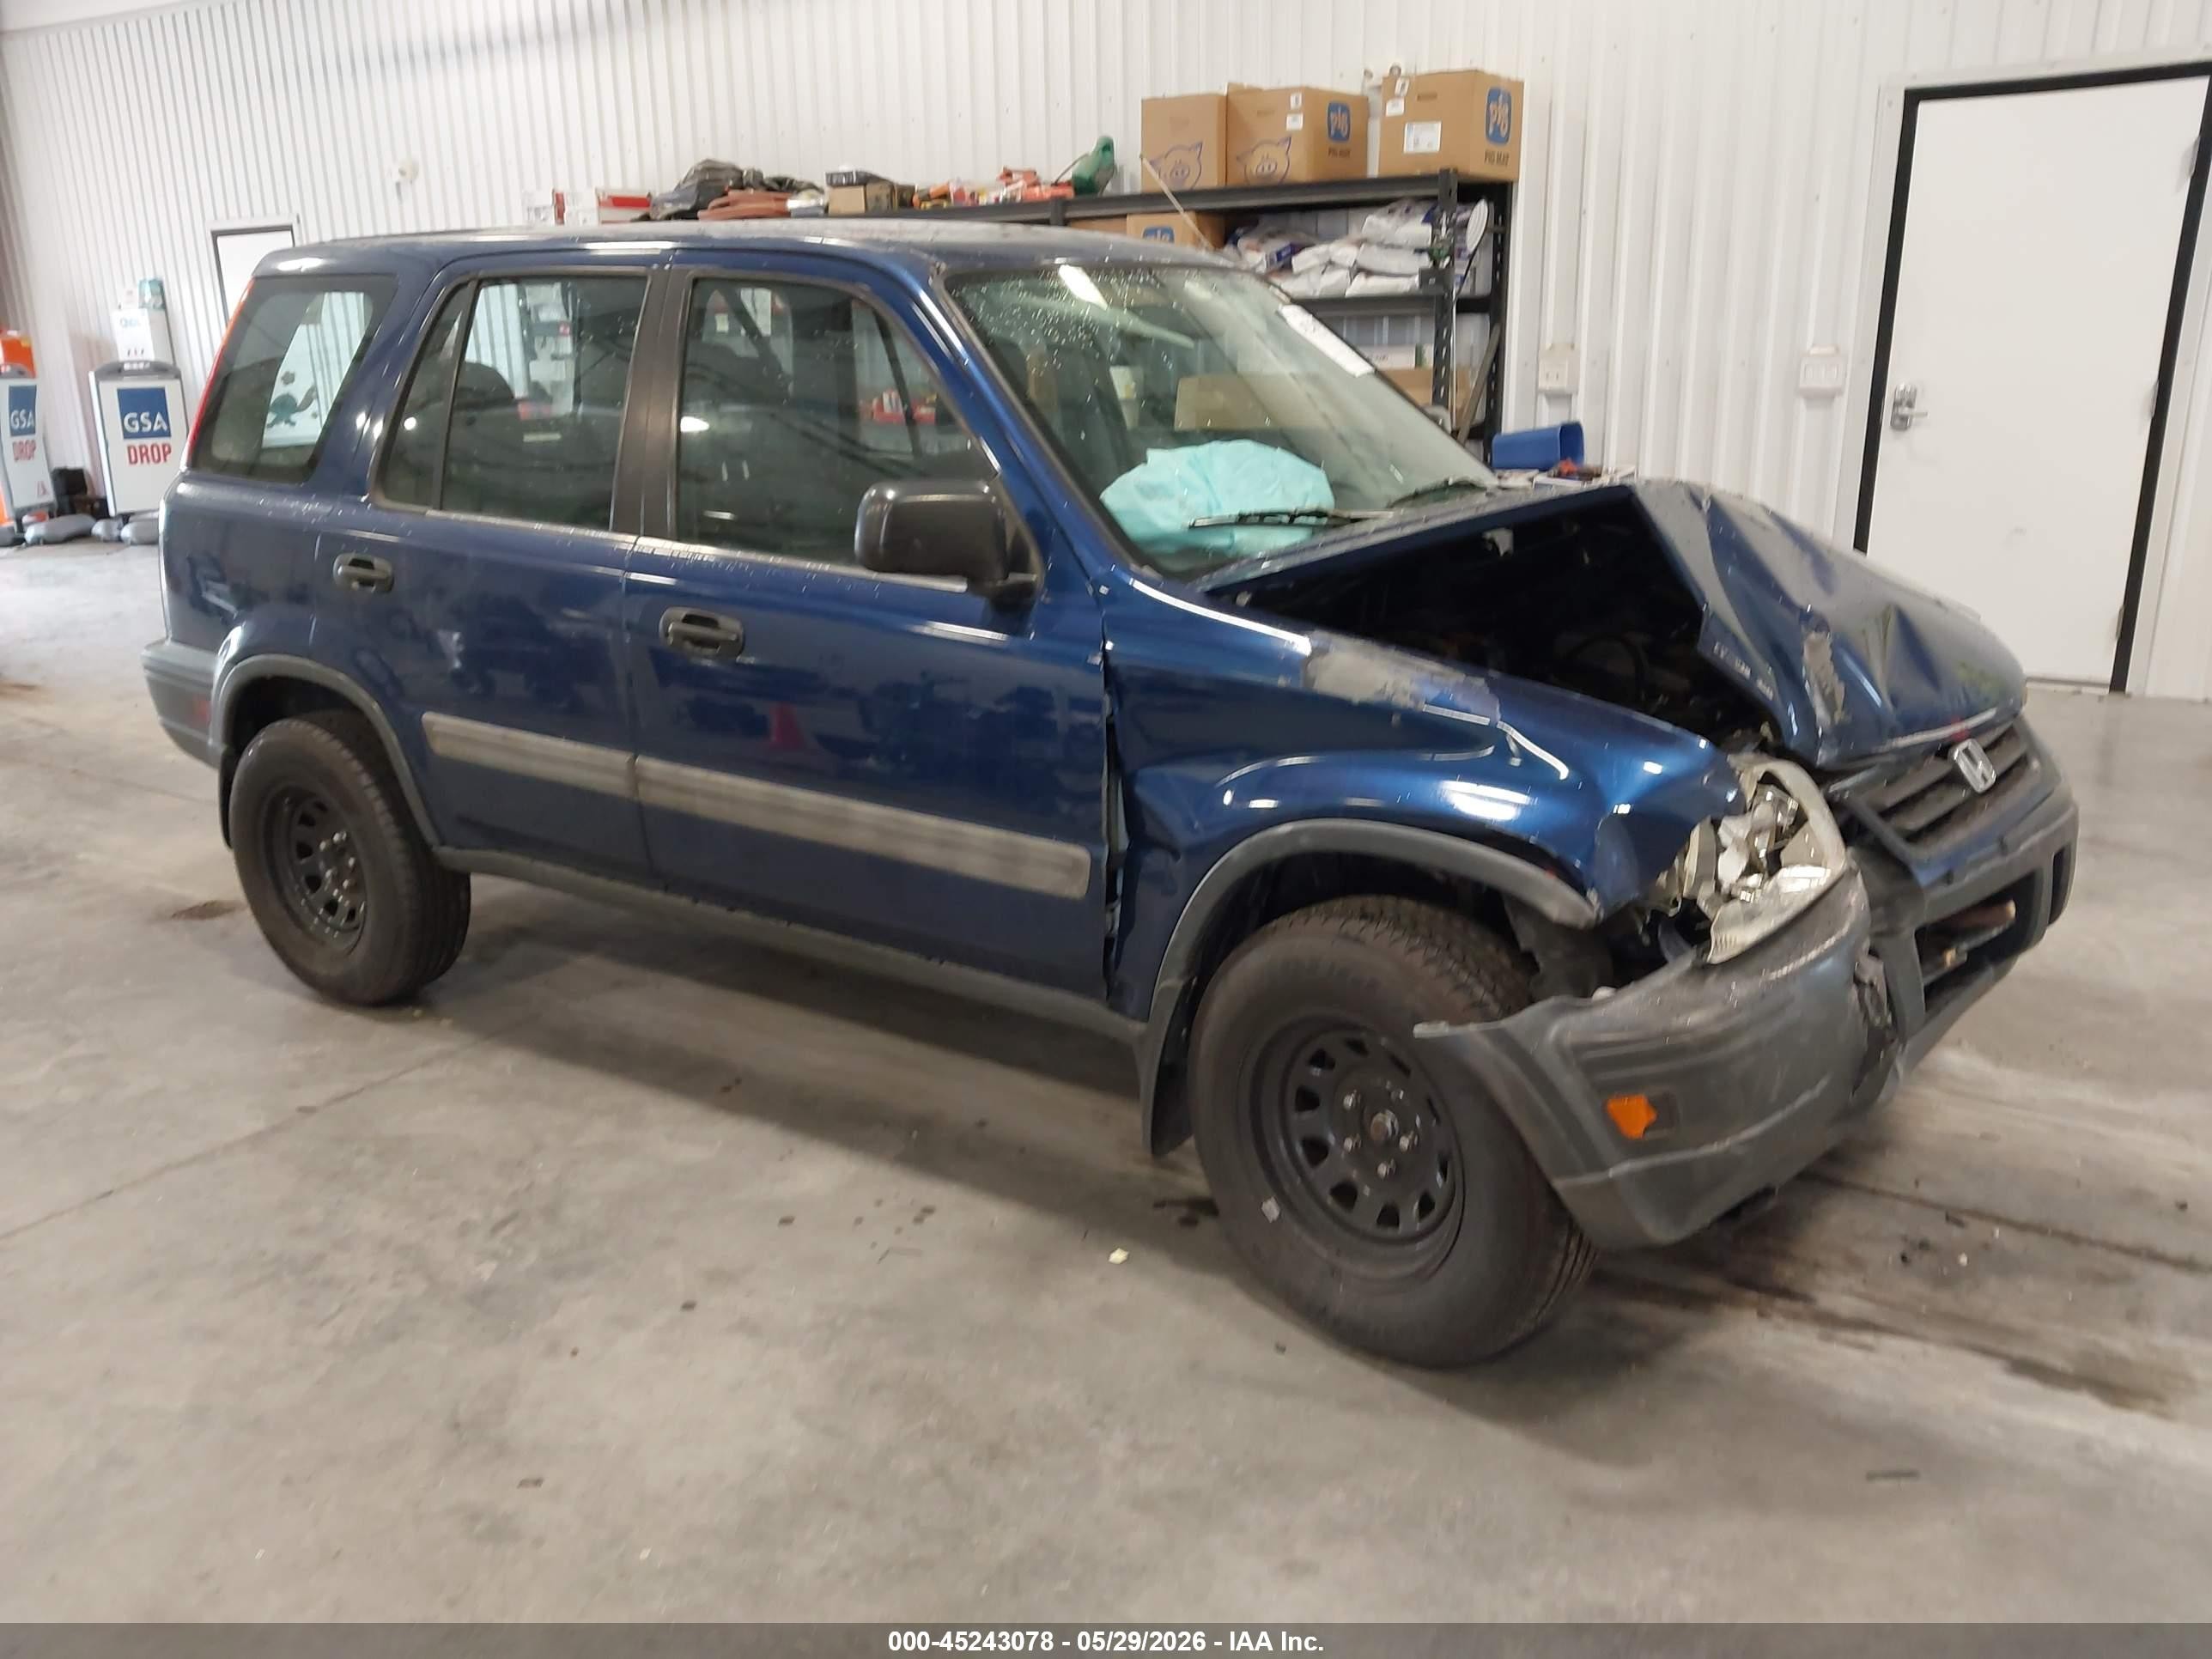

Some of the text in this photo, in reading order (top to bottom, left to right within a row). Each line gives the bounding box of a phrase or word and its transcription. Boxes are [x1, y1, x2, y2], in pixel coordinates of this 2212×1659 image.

[10, 409, 35, 430] GSA
[123, 411, 168, 433] GSA
[12, 439, 37, 462] DROP
[126, 442, 172, 465] DROP
